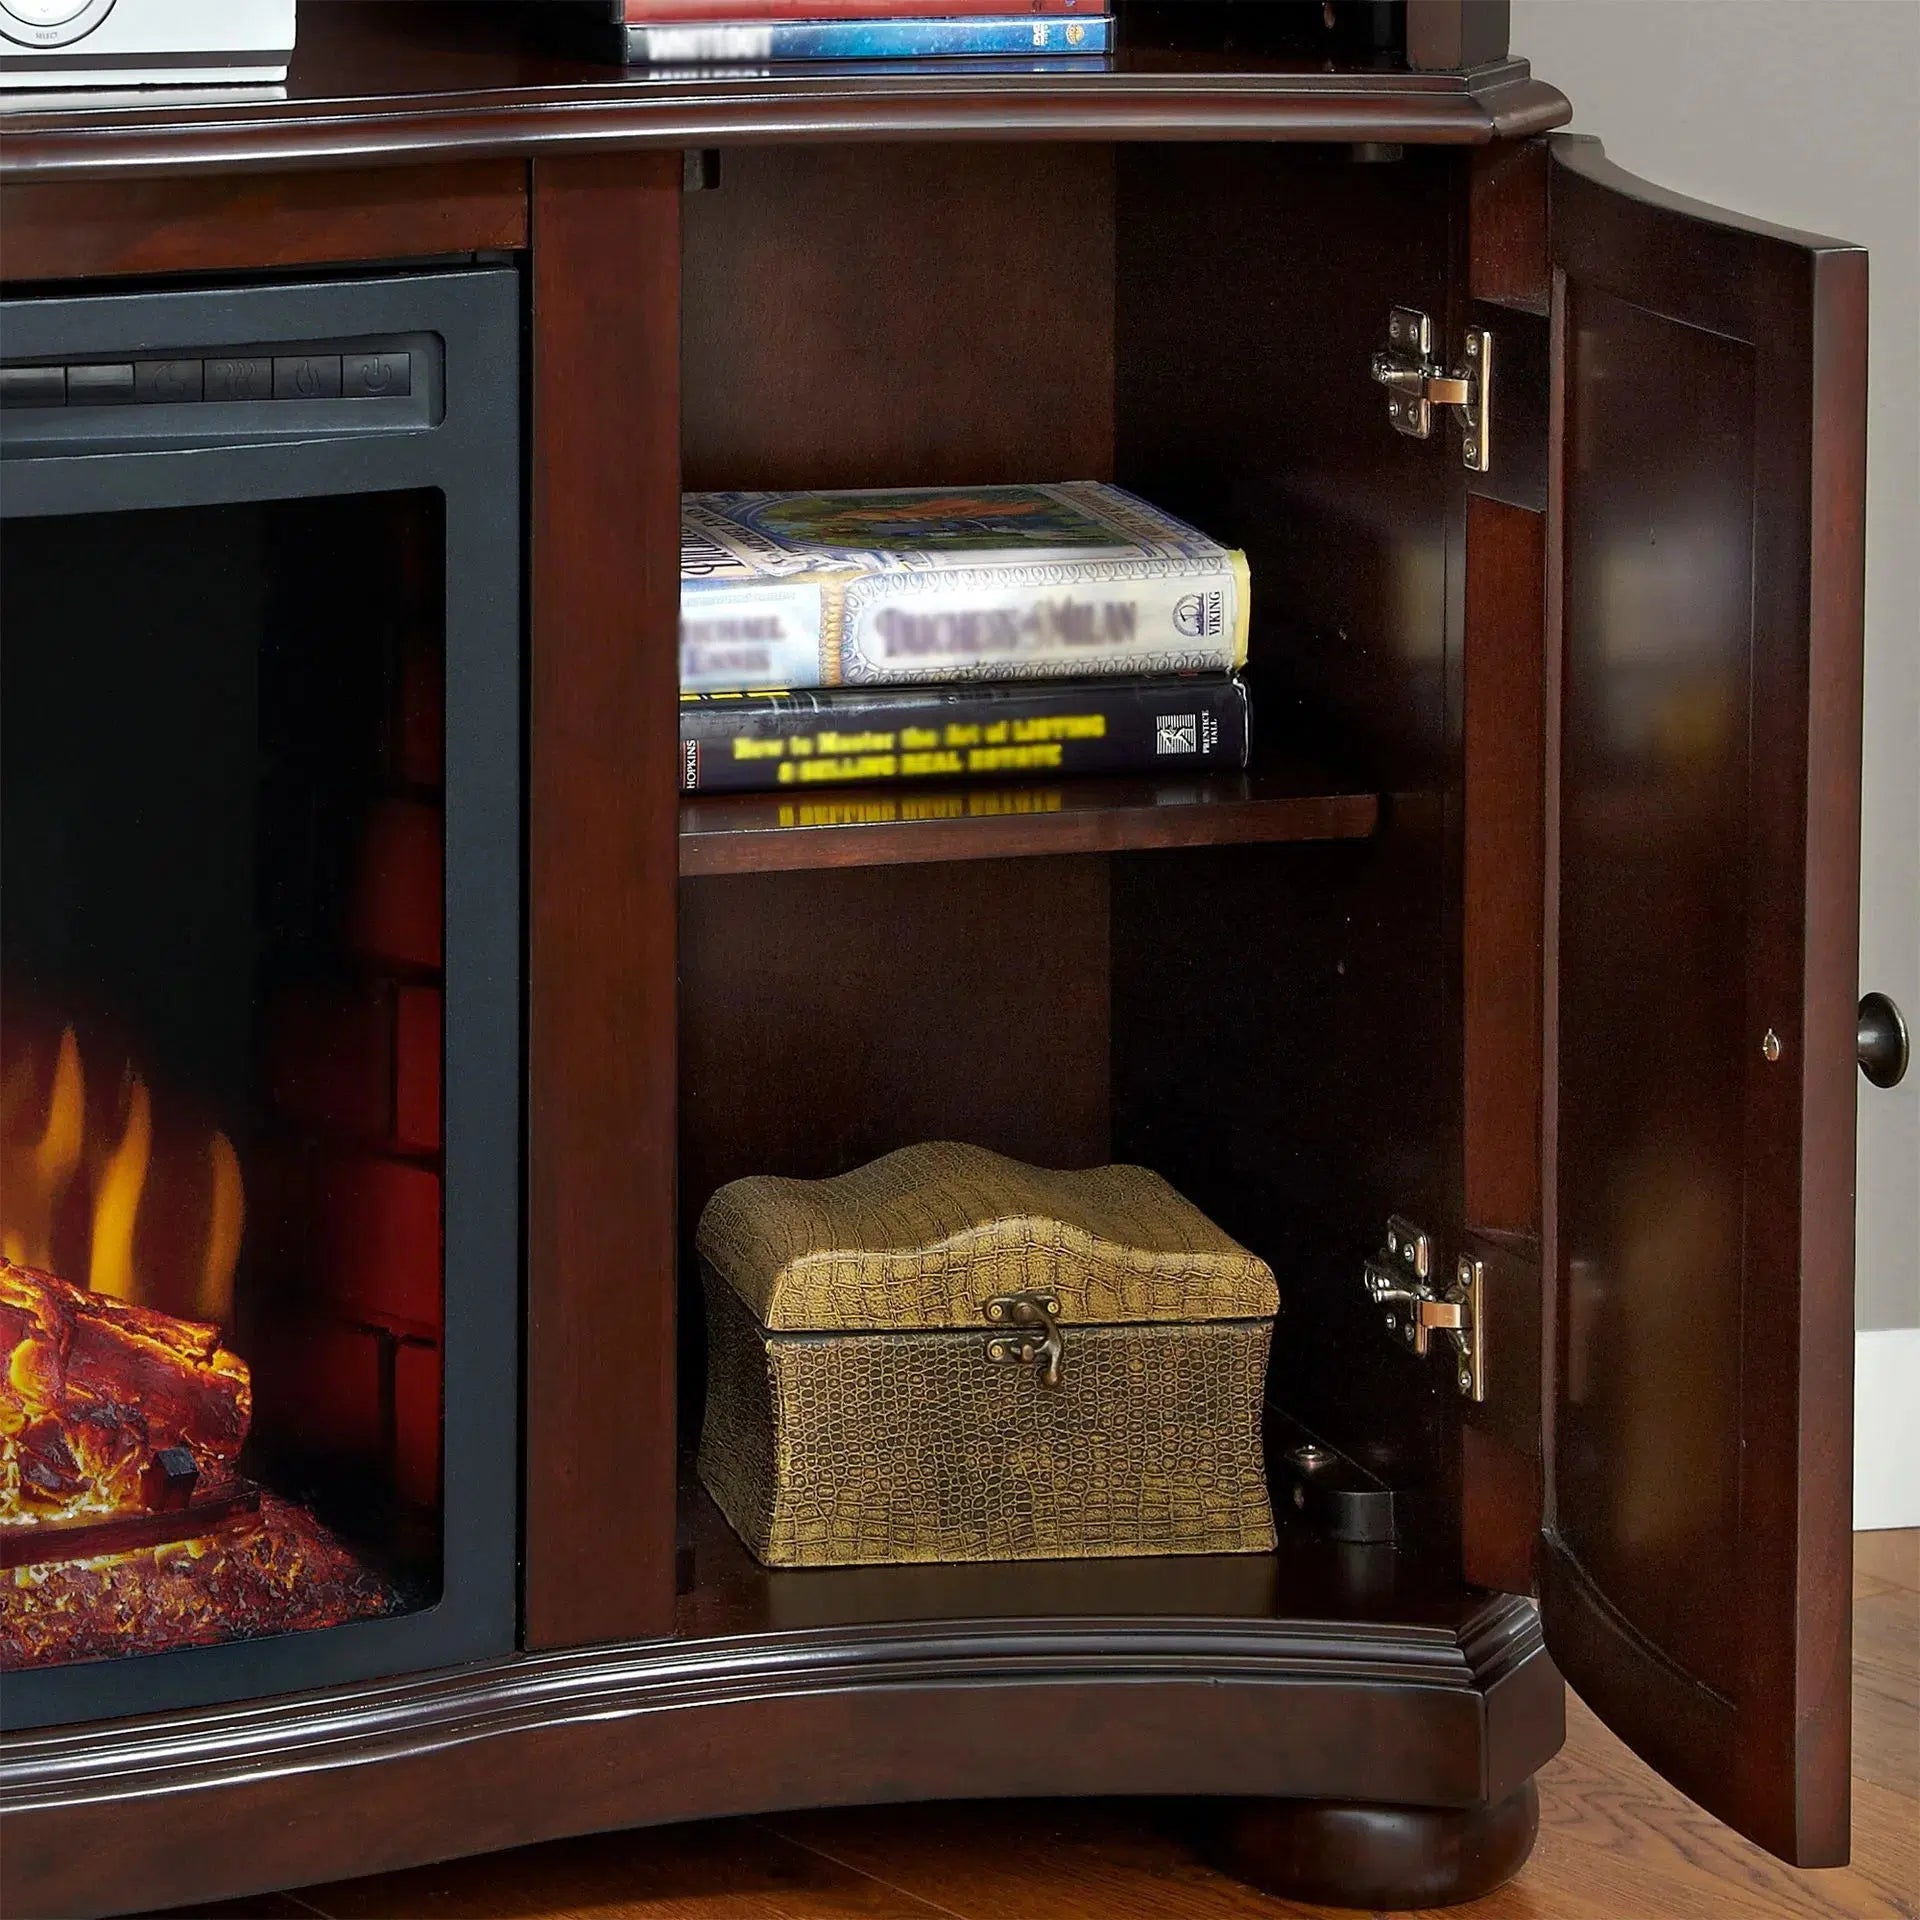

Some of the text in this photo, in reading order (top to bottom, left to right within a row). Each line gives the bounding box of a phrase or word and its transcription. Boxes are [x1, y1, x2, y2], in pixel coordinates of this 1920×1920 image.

[1208, 591, 1221, 636] VIKING
[1201, 709, 1210, 754] PRENTICE
[1210, 718, 1218, 744] HALL
[686, 739, 697, 789] HOPKINS
